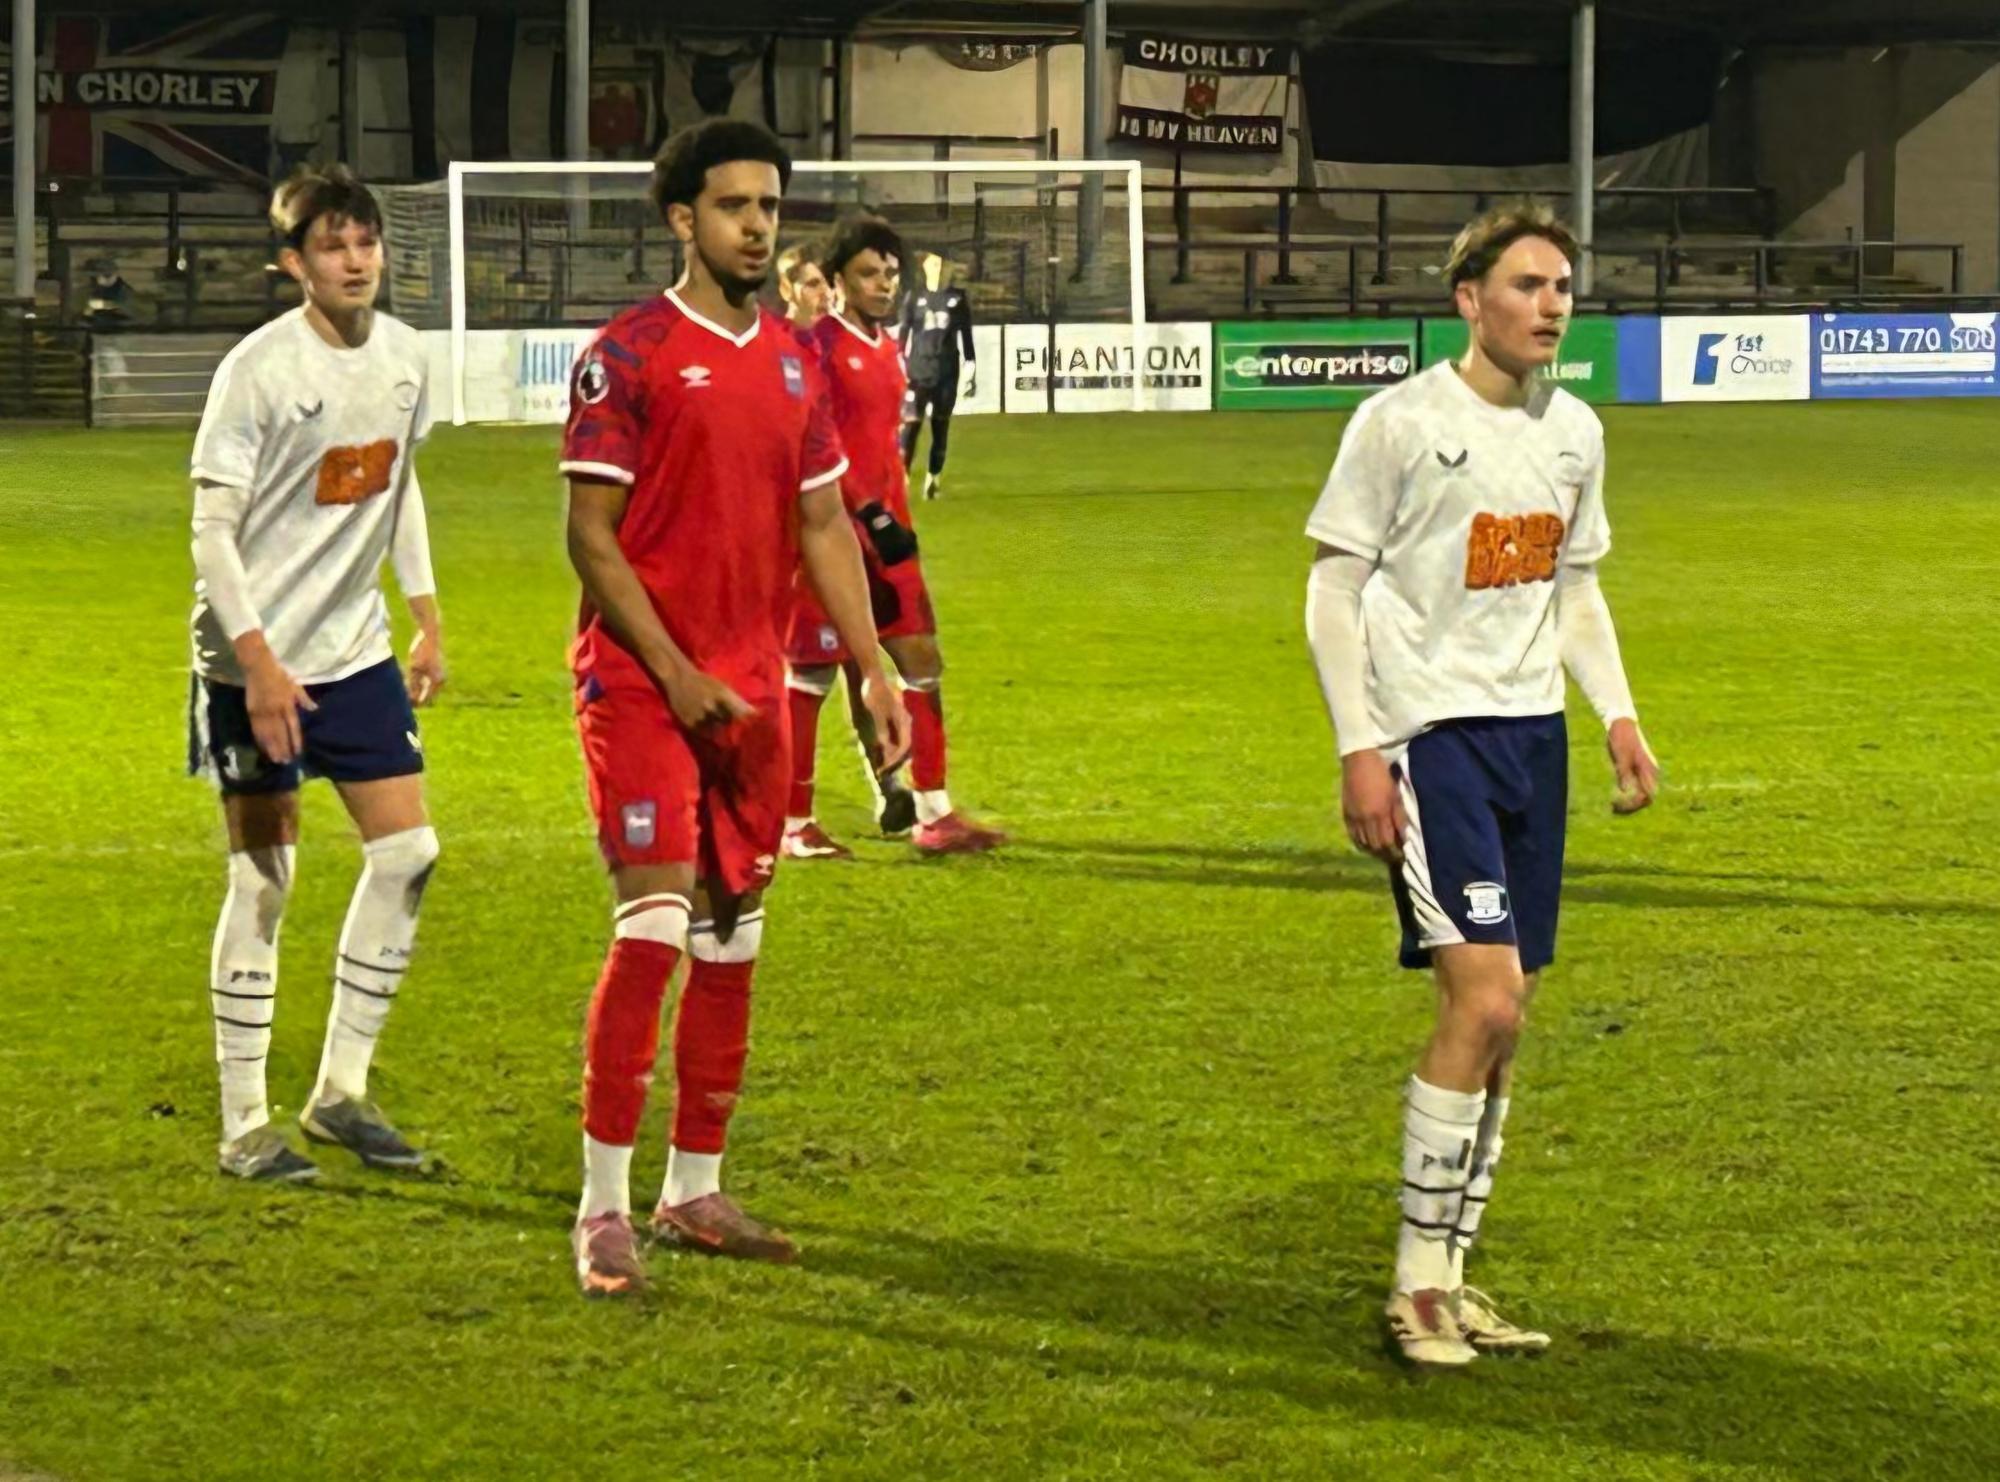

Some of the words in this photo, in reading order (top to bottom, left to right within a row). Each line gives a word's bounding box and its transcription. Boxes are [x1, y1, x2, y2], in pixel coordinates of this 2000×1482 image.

[1139, 40, 1274, 68] CHORLEY
[77, 72, 260, 107] CHORLEY
[1820, 328, 1890, 353] 01743
[1895, 327, 1941, 353] 770
[1015, 345, 1202, 373] PHANTOM
